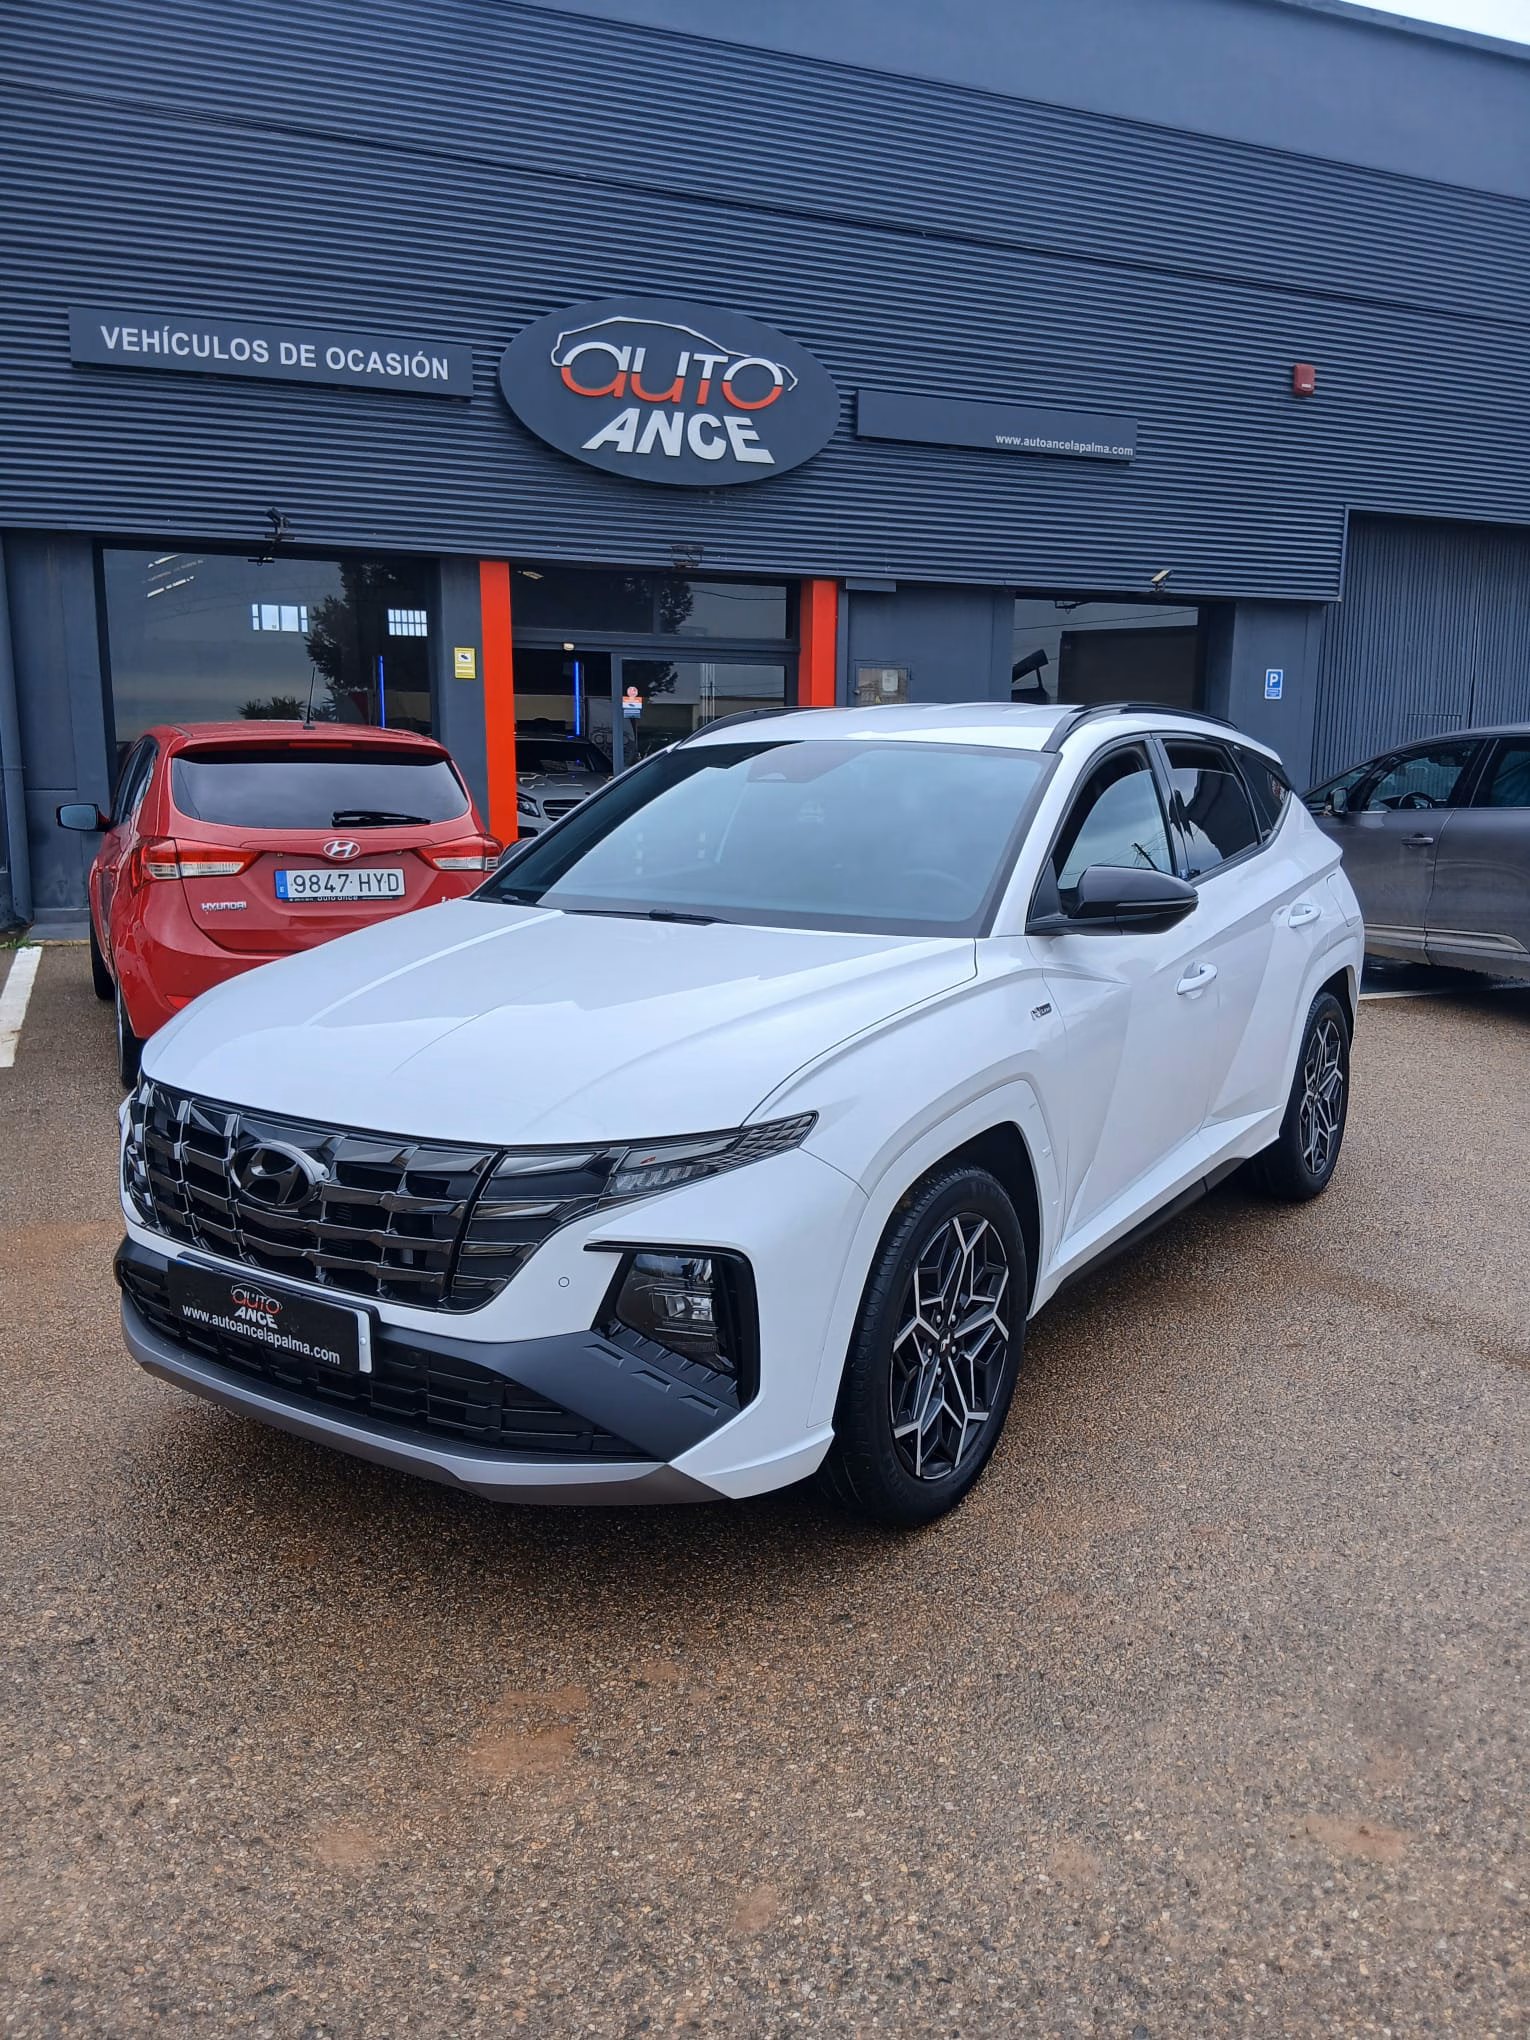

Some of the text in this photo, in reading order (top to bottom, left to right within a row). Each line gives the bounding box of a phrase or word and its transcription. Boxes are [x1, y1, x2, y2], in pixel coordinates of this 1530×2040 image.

[100, 325, 450, 381] VEHÍCULOS DE OCASIÓN
[581, 407, 776, 464] ANCE
[995, 434, 1134, 456] www.autoancelapalma.com
[1269, 673, 1279, 687] P
[293, 872, 400, 894] 9847 HYD
[201, 901, 247, 911] HYUNDAI
[234, 1306, 279, 1330] ANCE
[182, 1305, 341, 1365] www.autoancelapalma.com
